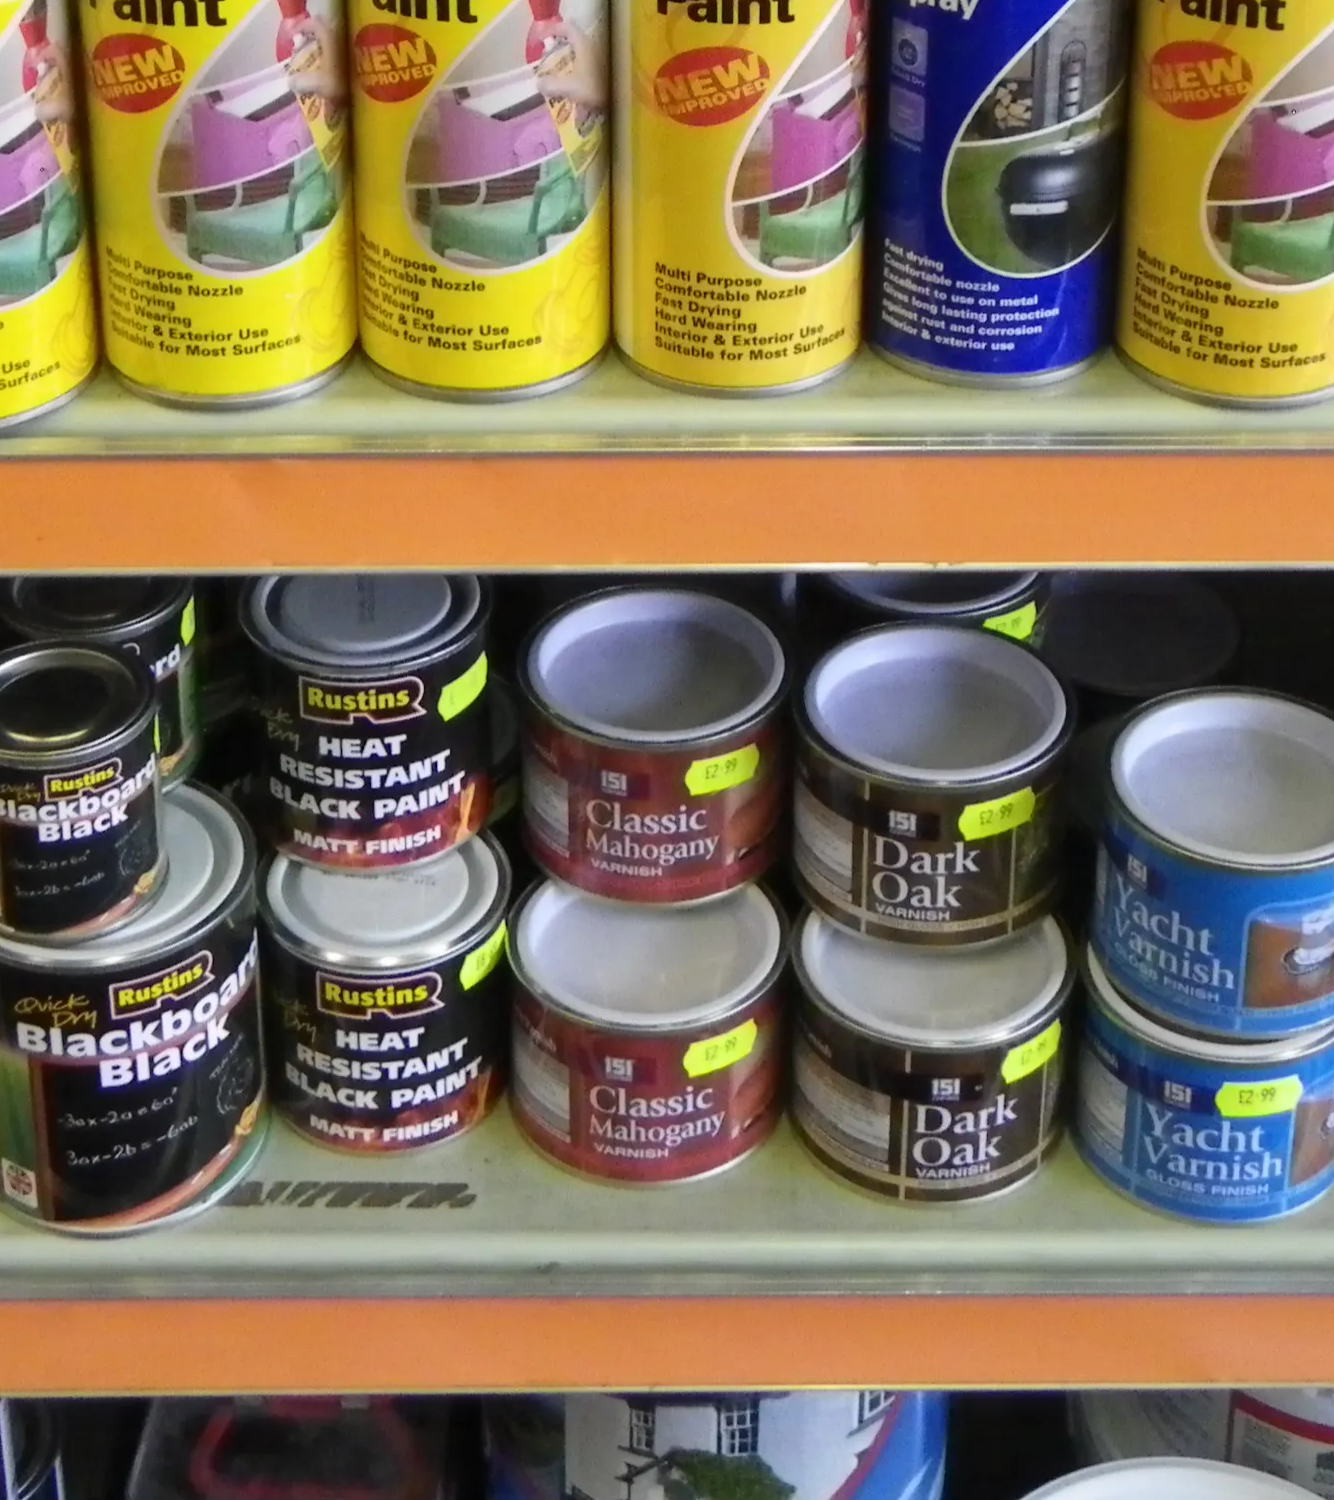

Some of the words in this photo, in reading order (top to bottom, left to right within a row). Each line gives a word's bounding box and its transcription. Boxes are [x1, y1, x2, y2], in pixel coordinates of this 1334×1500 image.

[655, 261, 691, 285] Multi
[696, 275, 762, 288] Purpose
[956, 280, 1000, 293] nozzle
[655, 277, 751, 302] Comfortable
[756, 283, 806, 302] Nozzle
[1000, 294, 1038, 307] metal
[655, 292, 685, 312] Fast
[688, 304, 741, 319] Drying
[991, 306, 1060, 323] protection
[655, 323, 709, 344] Interior
[732, 331, 795, 347] Exterior
[799, 323, 824, 339] Use
[692, 317, 757, 334] Wearing
[978, 323, 1043, 336] corrosion
[232, 334, 300, 356] Surfaces
[655, 336, 714, 360] Suitable
[749, 344, 787, 361] Most
[935, 334, 987, 350] exterior
[308, 687, 410, 711] Rustins
[319, 734, 407, 758] HEAT
[50, 766, 115, 793] Rustins
[280, 749, 451, 789] RESISTANT
[269, 777, 361, 819] BLACK
[374, 770, 466, 819] PAINT
[38, 803, 129, 843] Black
[586, 800, 707, 833] Classic
[294, 829, 360, 854] MATT
[366, 825, 441, 854] FINISH
[586, 832, 719, 864] Mahogany
[873, 835, 980, 873] Dark
[592, 860, 662, 877] VARNISH
[872, 873, 961, 908] Oak
[875, 903, 950, 921] VARNISH
[118, 962, 204, 1008] Rustins
[325, 982, 428, 1006] Rustins
[99, 1012, 231, 1088] Black
[336, 1027, 425, 1051] HEAT
[297, 1037, 468, 1081] RESISTANT
[285, 1062, 379, 1109] BLACK
[391, 1056, 482, 1107] PAINT
[590, 1086, 714, 1119] Classic
[916, 1095, 1018, 1133] Dark
[310, 1114, 374, 1141] MATT
[383, 1110, 458, 1142] FINISH
[589, 1111, 725, 1145] Mahogany
[1143, 1105, 1264, 1154] Yacht
[594, 1143, 669, 1158] VARNISH
[913, 1131, 1001, 1166] Oak
[1144, 1142, 1283, 1180] Varnish
[916, 1163, 991, 1179] VARNISH
